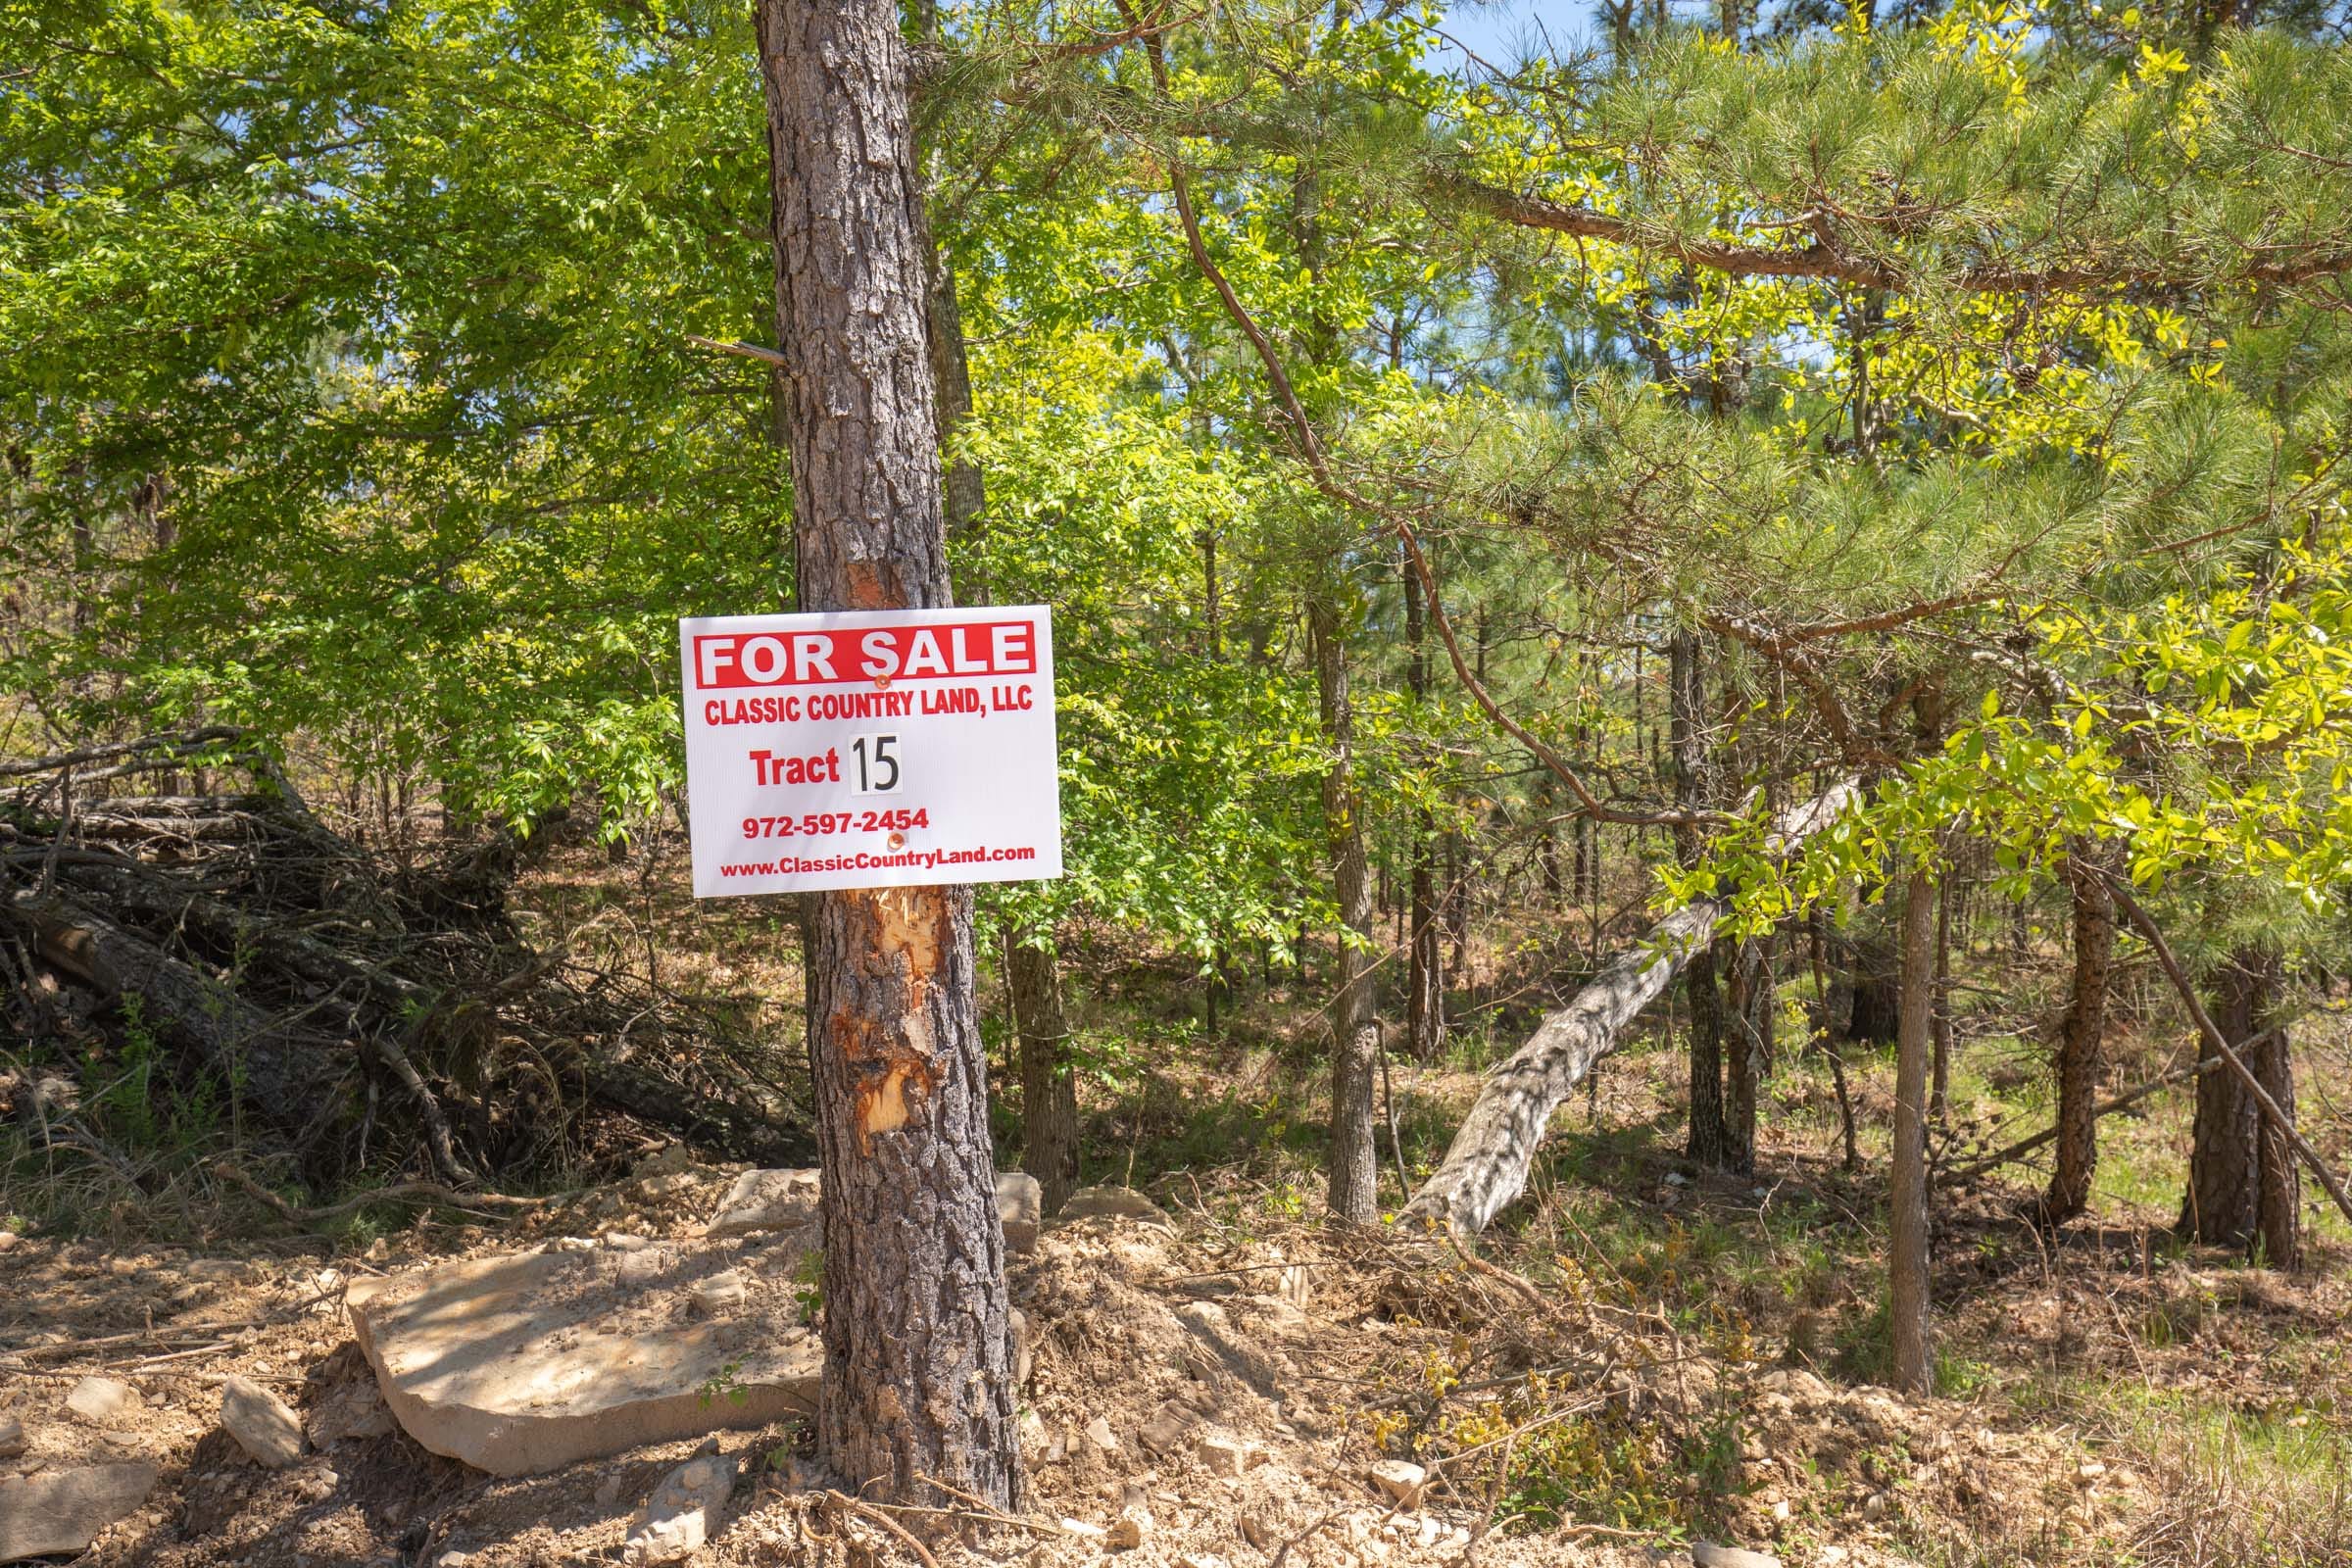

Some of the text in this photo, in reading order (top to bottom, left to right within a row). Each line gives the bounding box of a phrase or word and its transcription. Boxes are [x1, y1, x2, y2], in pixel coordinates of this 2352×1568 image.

[700, 625, 1030, 685] FOR SALE
[705, 684, 1033, 726] CLASSIC COUNTRY LAND, LLC
[749, 736, 899, 792] Tract 15
[742, 808, 929, 839] 972-597-2454
[721, 847, 1036, 877] www.ClassicCountryLand.com
